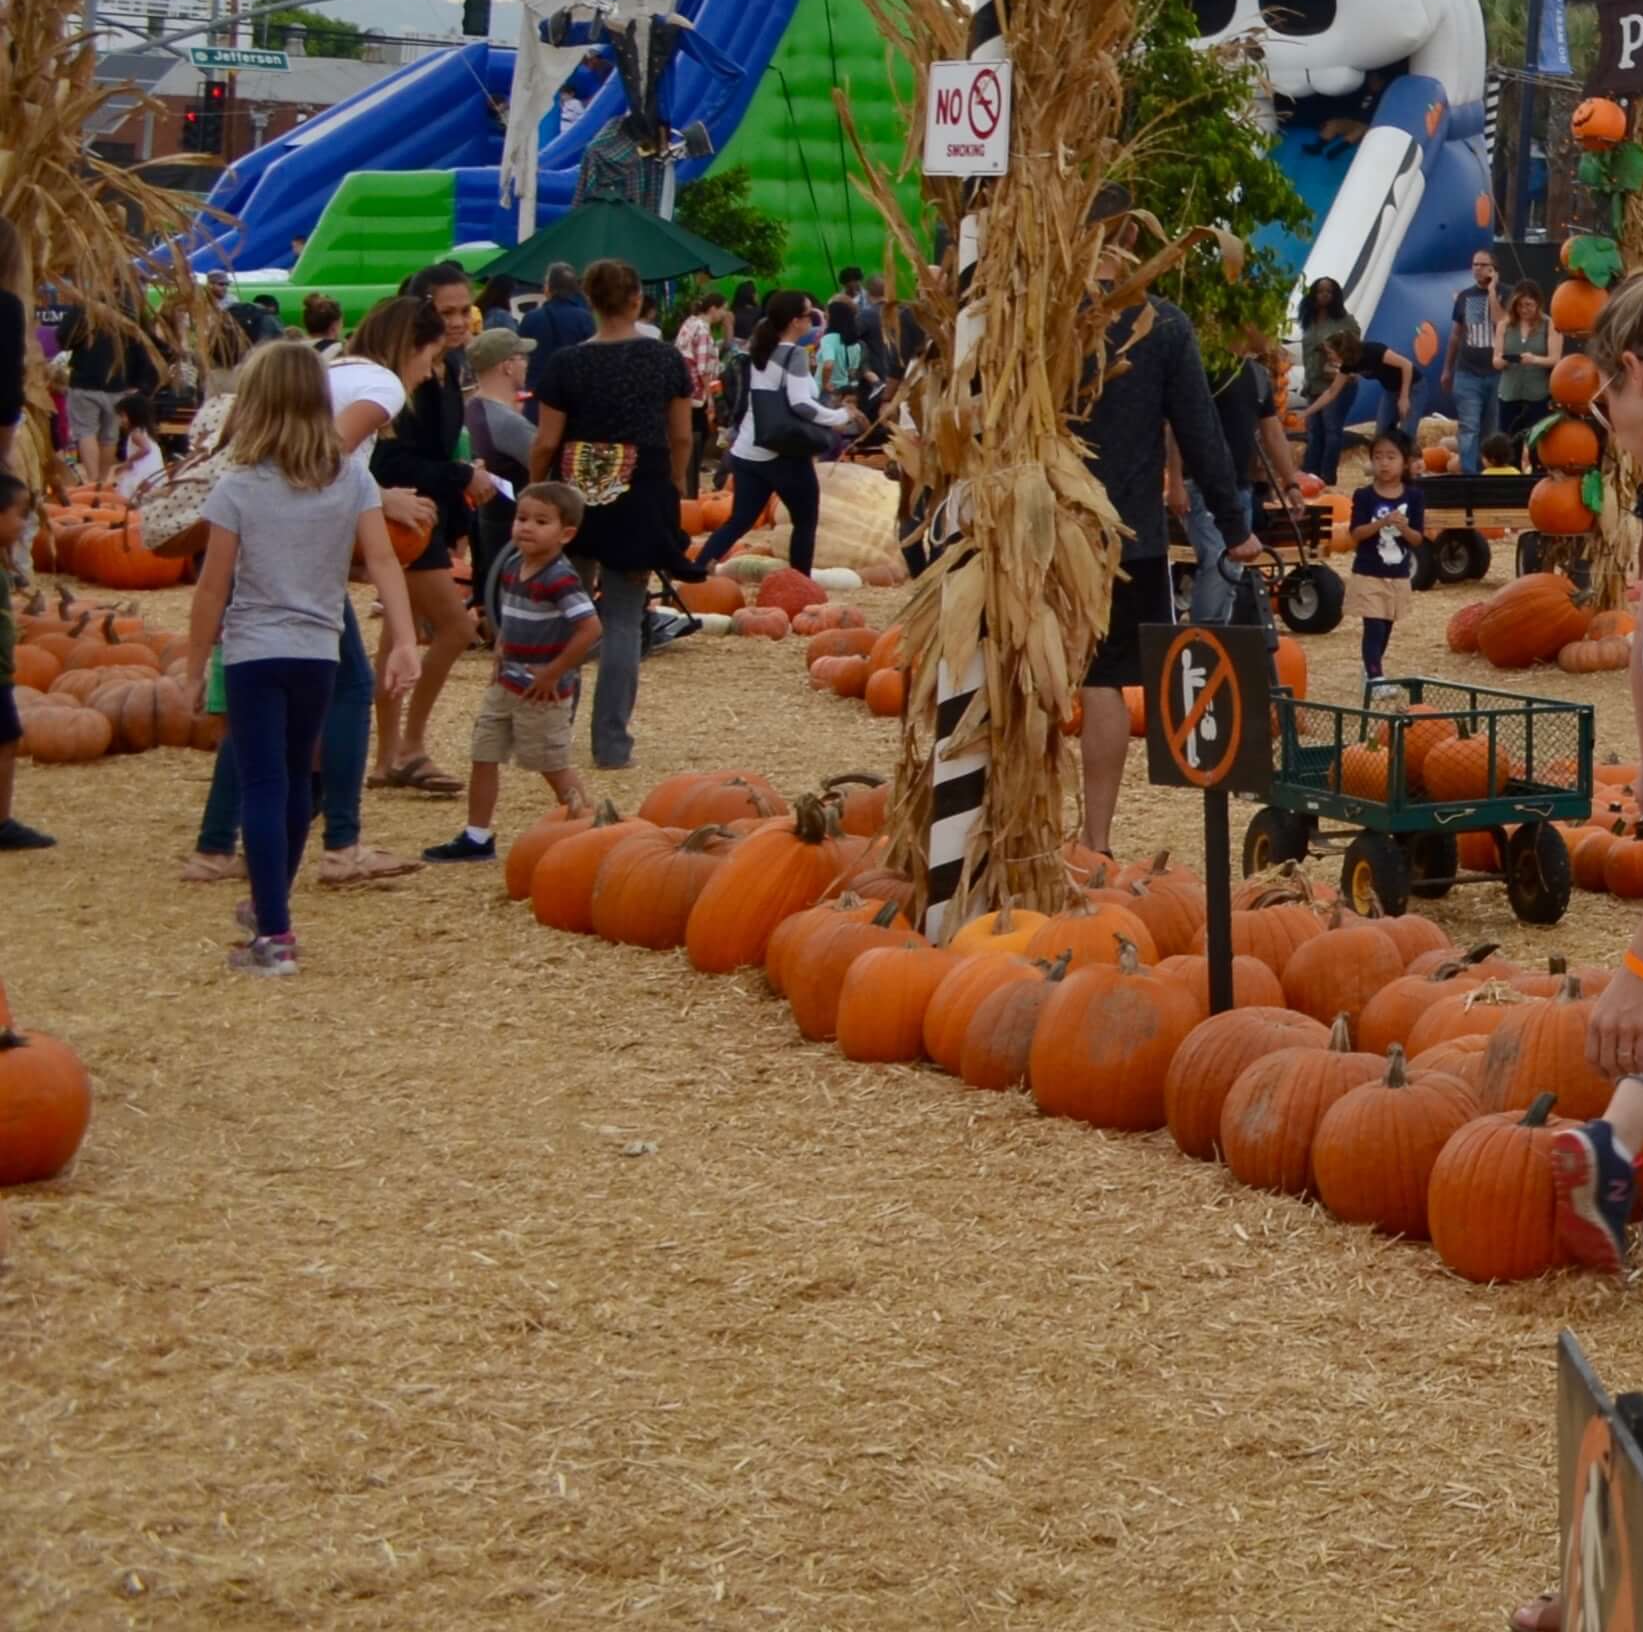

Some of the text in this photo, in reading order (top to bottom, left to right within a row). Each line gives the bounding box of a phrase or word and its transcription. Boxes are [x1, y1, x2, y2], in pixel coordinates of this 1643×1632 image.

[214, 51, 282, 64] Jefferson
[935, 88, 963, 125] NO
[946, 143, 985, 158] SMOKING
